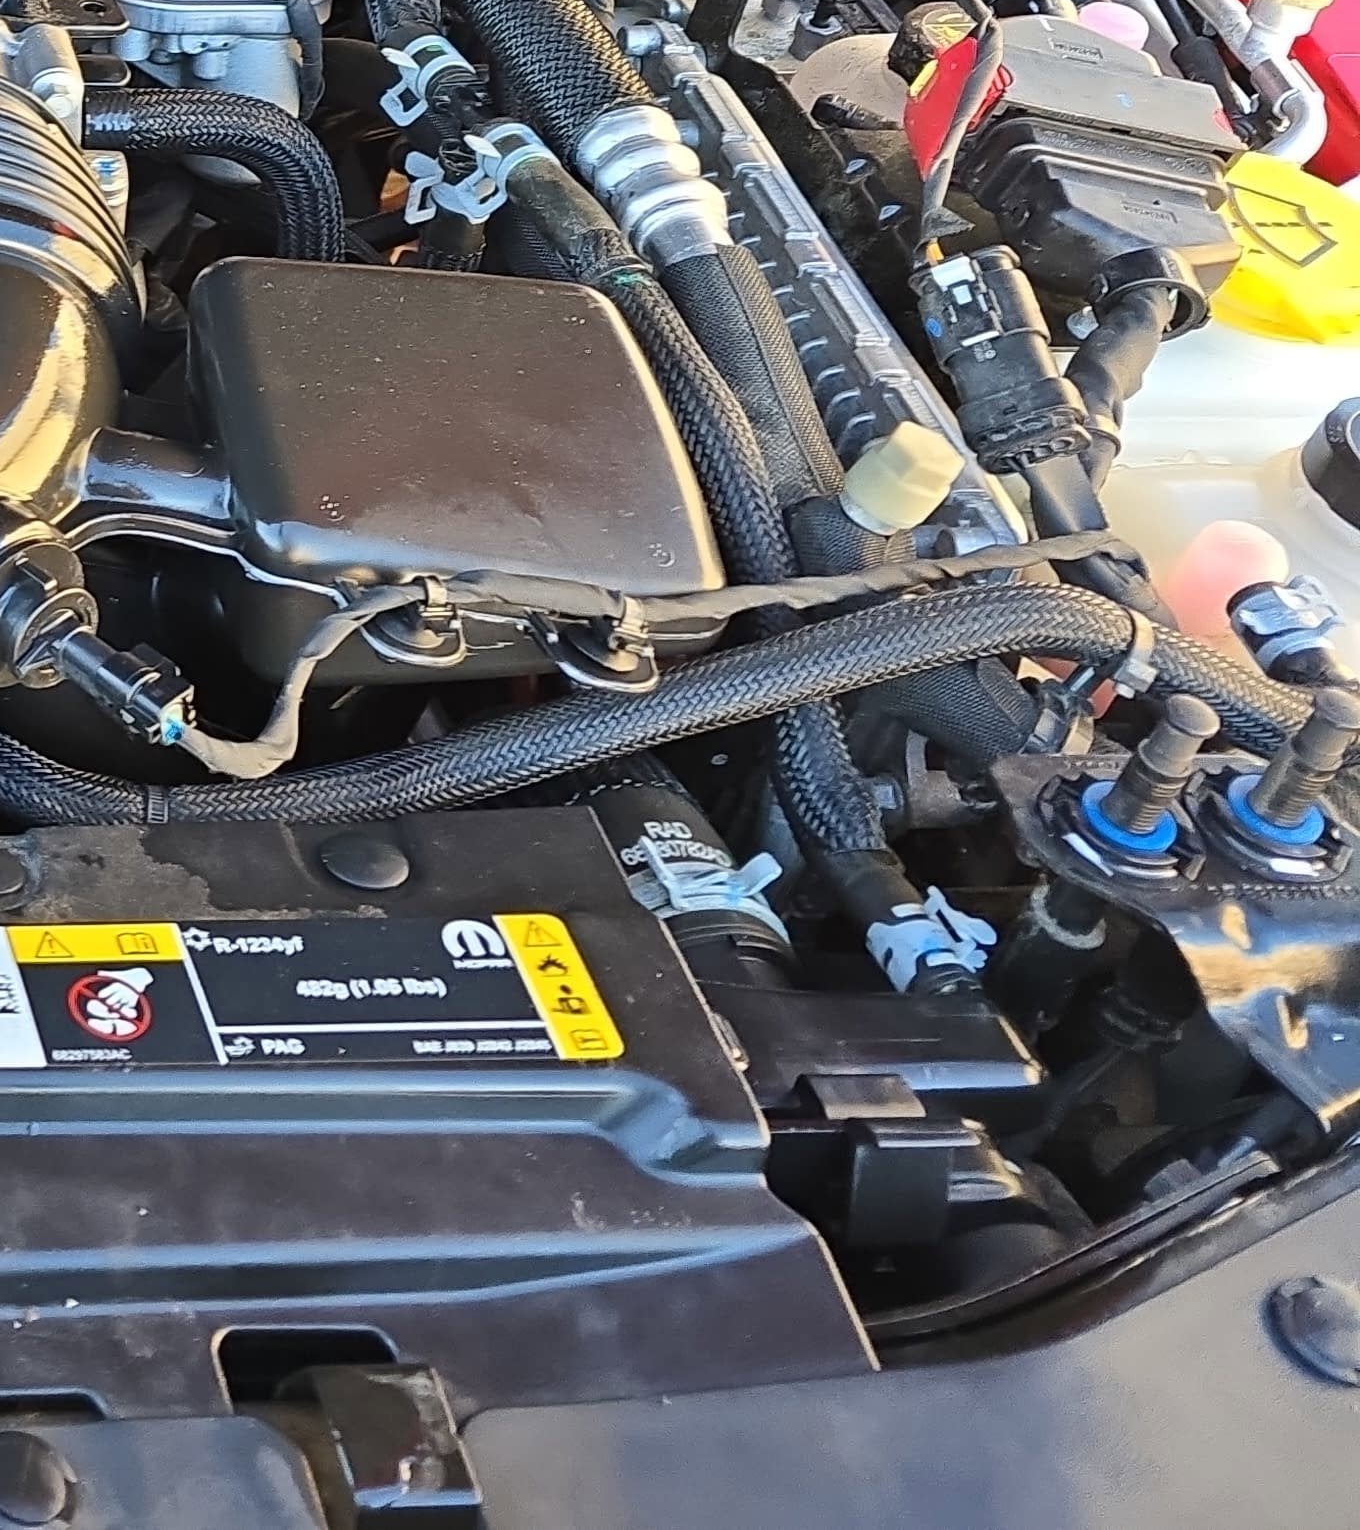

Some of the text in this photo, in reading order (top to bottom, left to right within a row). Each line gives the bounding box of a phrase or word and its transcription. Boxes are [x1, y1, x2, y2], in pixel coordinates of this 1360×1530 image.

[643, 821, 693, 840] RAD
[620, 839, 733, 868] 6880782AD
[212, 935, 305, 956] R-1234yf
[260, 1038, 306, 1055] PAG
